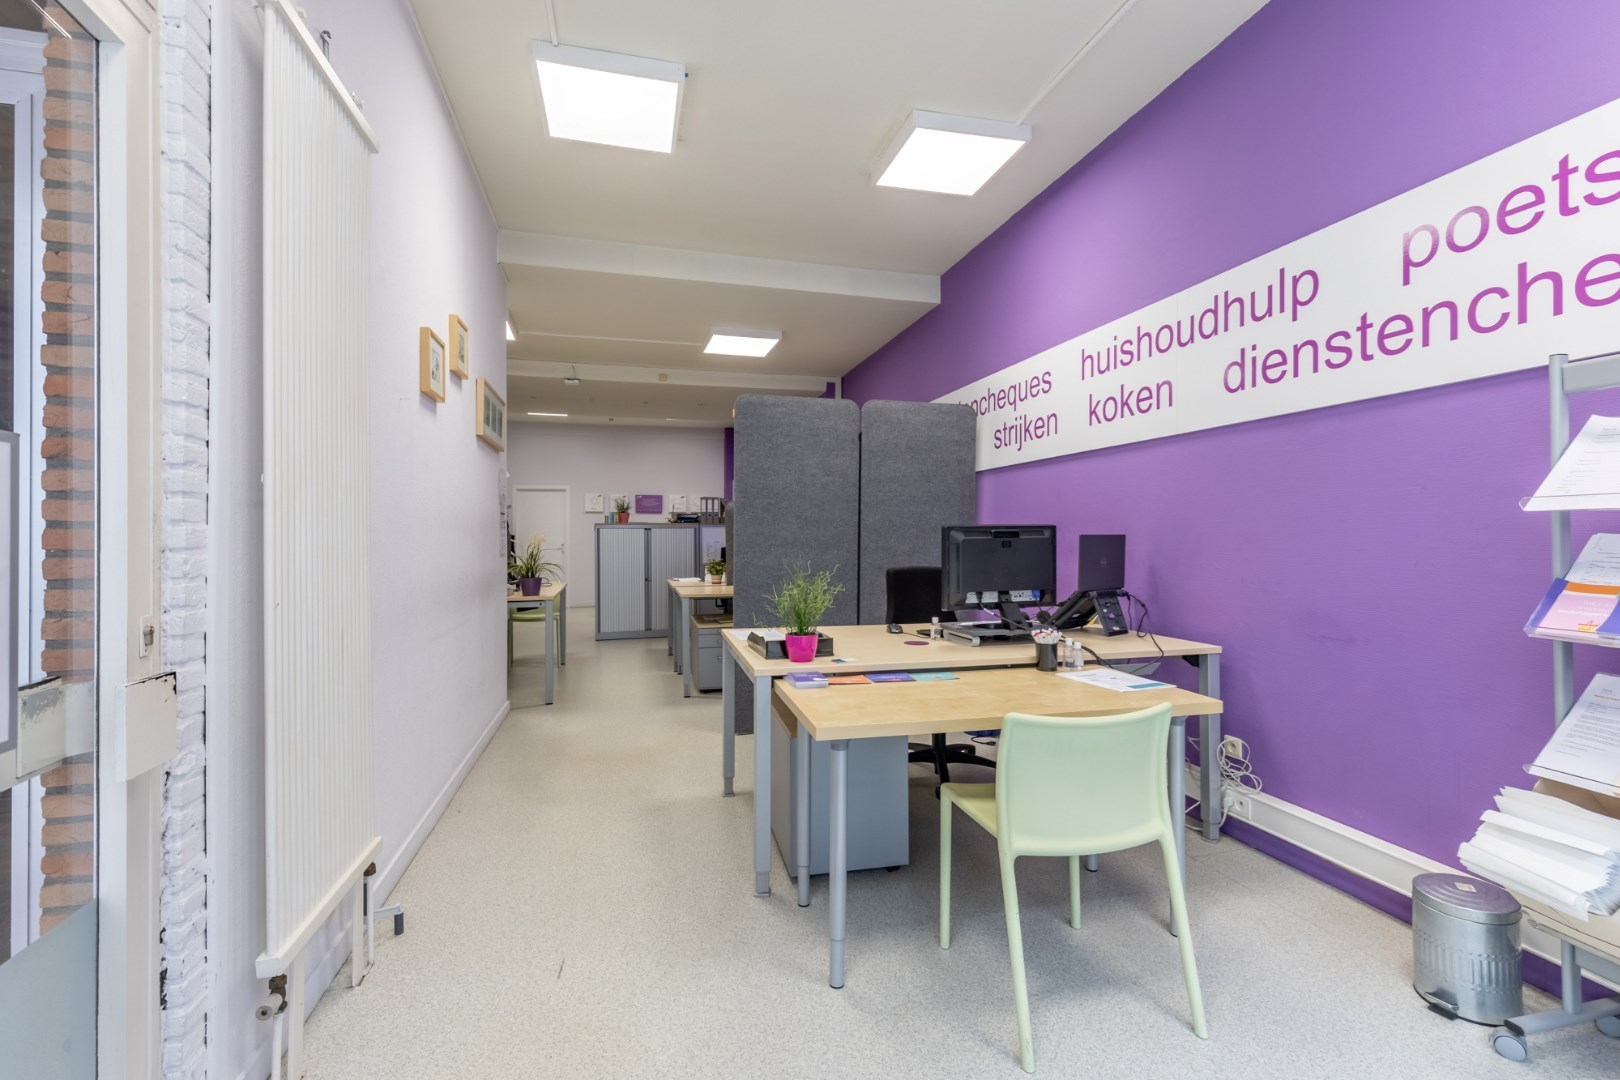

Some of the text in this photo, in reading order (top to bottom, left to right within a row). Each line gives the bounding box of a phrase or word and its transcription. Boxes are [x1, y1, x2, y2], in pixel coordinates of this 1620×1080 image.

[993, 253, 1620, 452] strijken koken dienstenche
[1080, 267, 1320, 382] huishoudhulp
[1402, 149, 1620, 287] poets
